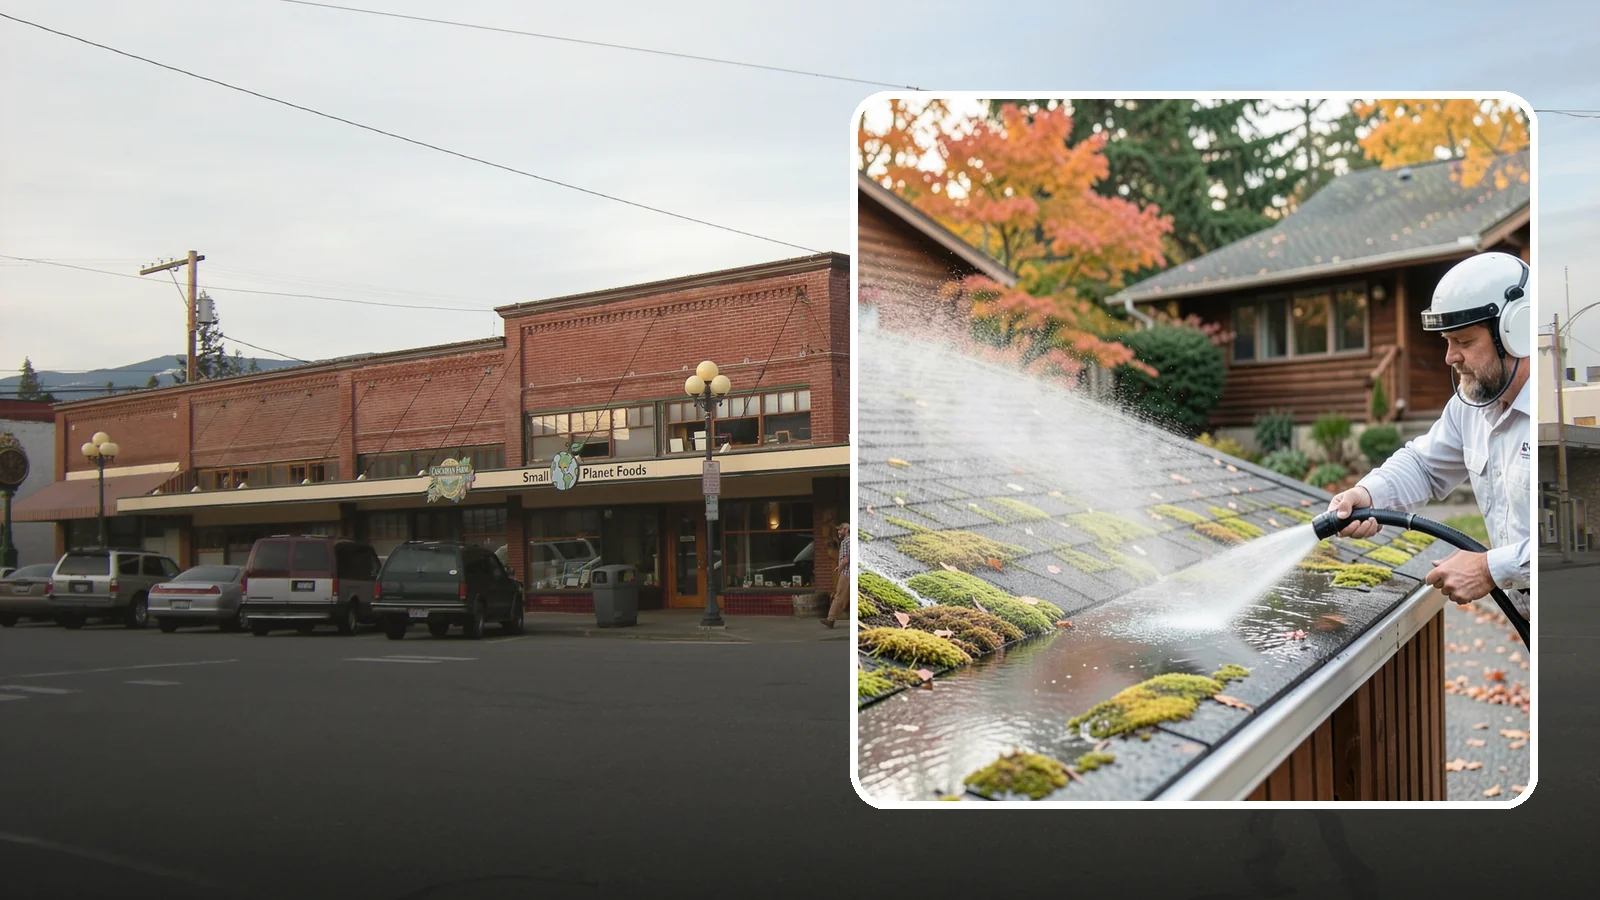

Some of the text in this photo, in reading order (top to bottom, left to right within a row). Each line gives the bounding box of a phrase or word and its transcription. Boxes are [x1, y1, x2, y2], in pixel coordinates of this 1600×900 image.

[523, 464, 647, 483] Small Planet Foods
